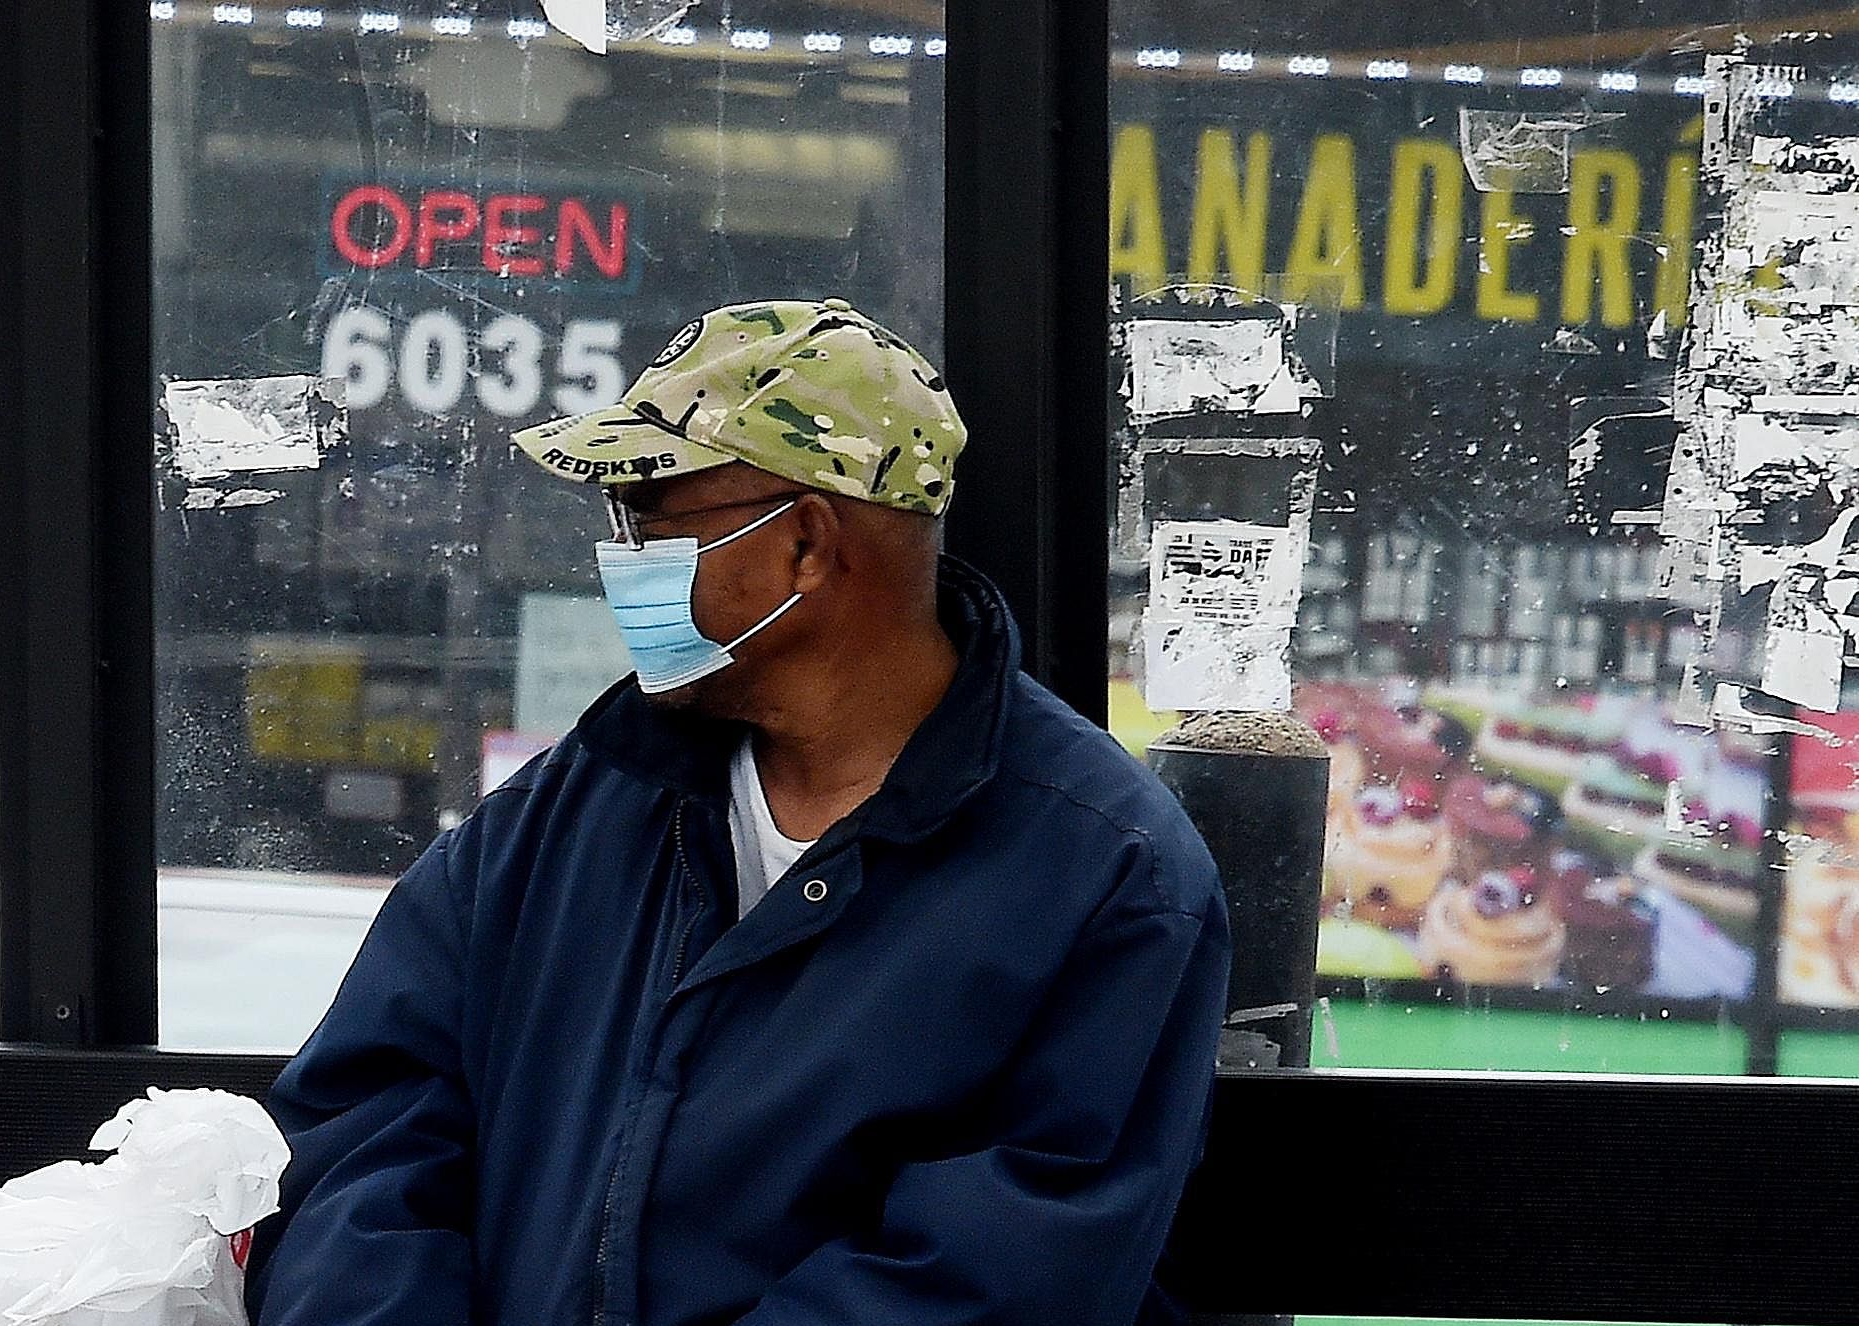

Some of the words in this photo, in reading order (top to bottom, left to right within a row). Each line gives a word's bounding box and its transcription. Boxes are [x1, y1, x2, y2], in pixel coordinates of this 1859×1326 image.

[332, 184, 627, 277] OPEN
[1109, 112, 1783, 330] ANADERÍ
[322, 304, 625, 417] 6035
[542, 449, 676, 476] REDSKINS
